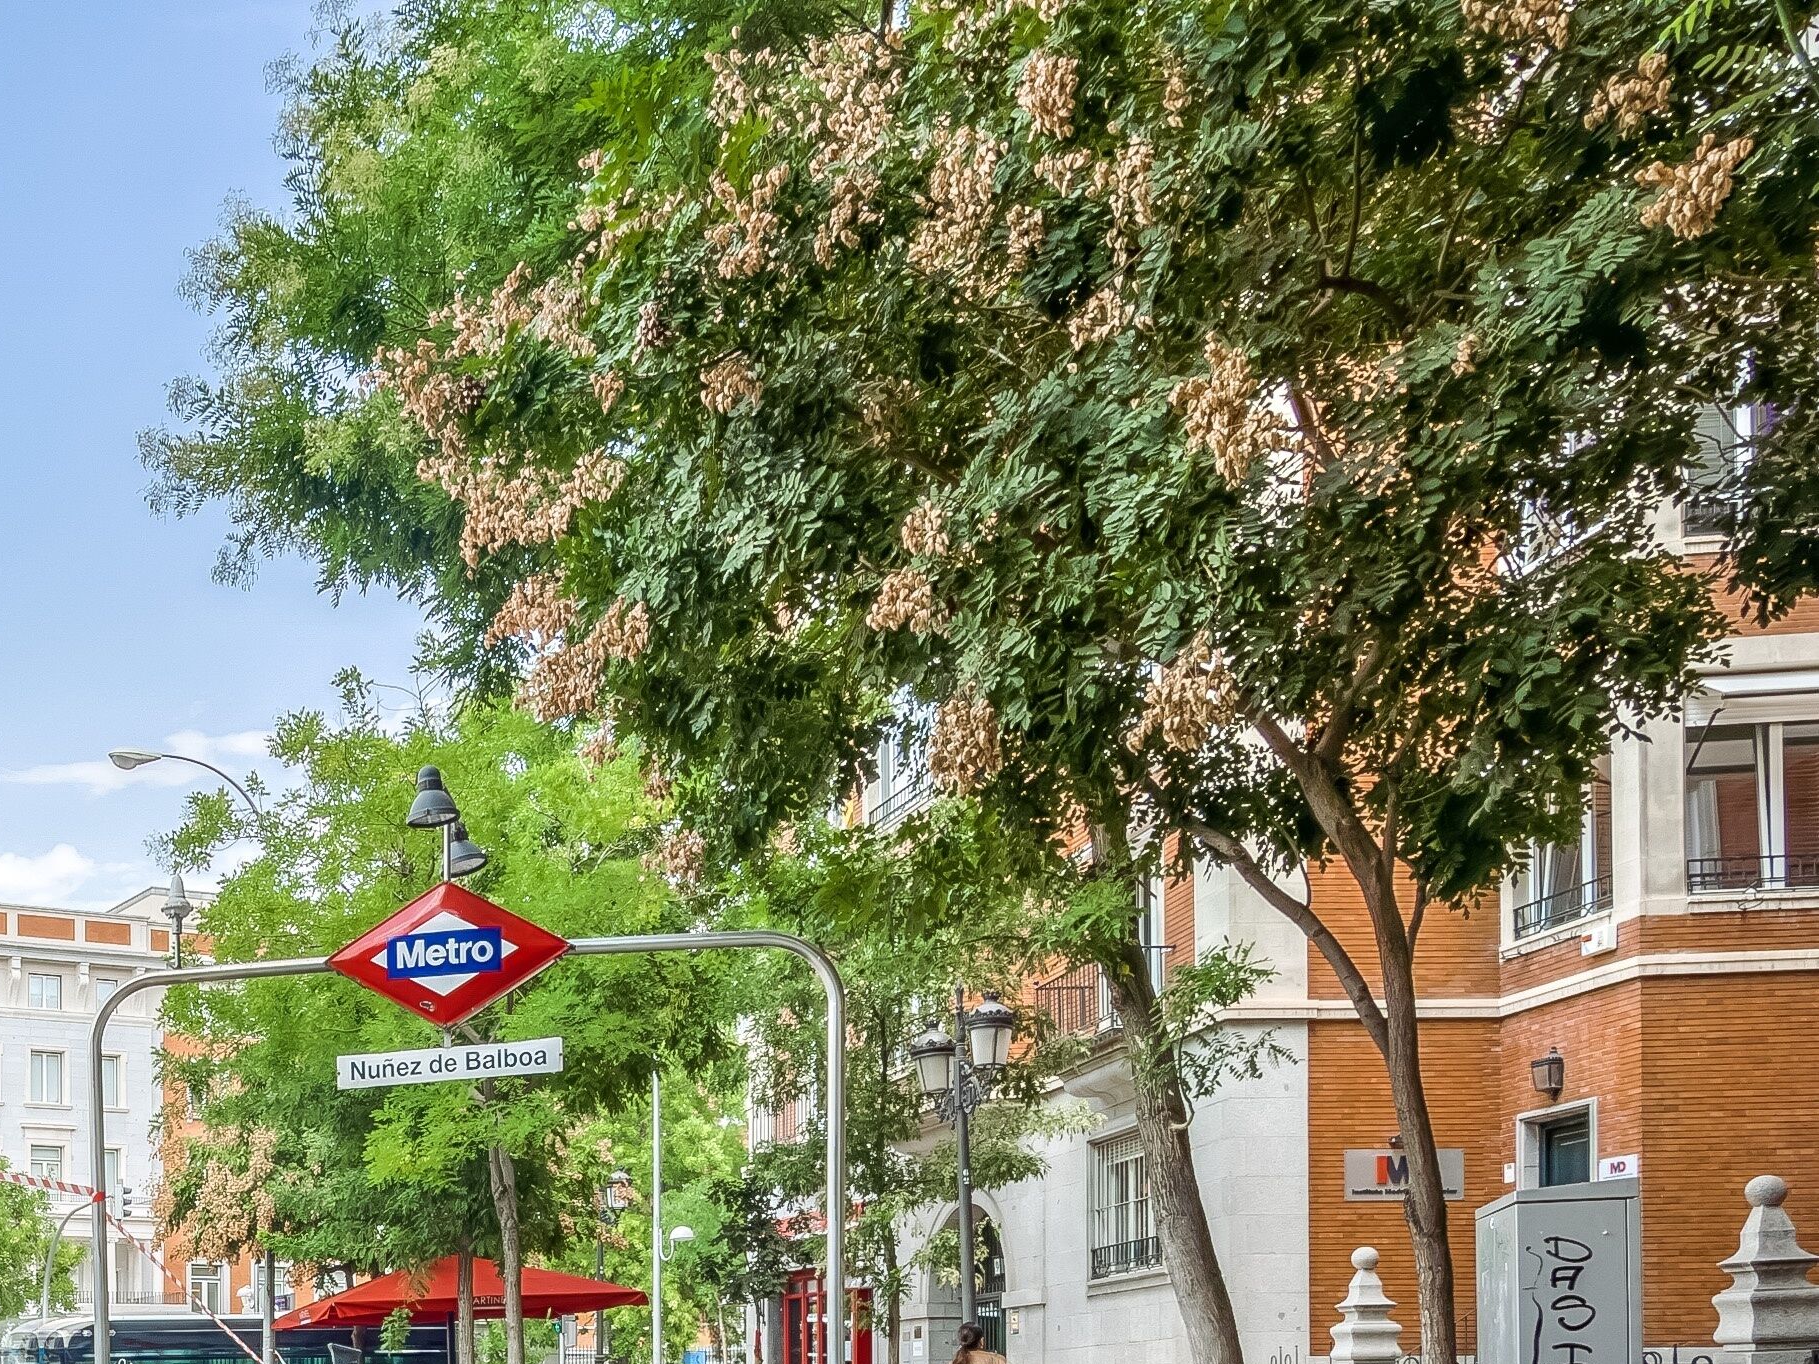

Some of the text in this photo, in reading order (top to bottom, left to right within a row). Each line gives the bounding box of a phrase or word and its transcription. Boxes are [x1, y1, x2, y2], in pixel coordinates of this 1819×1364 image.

[396, 937, 494, 969] Metro
[350, 1049, 547, 1080] Nuñez de Balboa
[1376, 1155, 1409, 1185] IM
